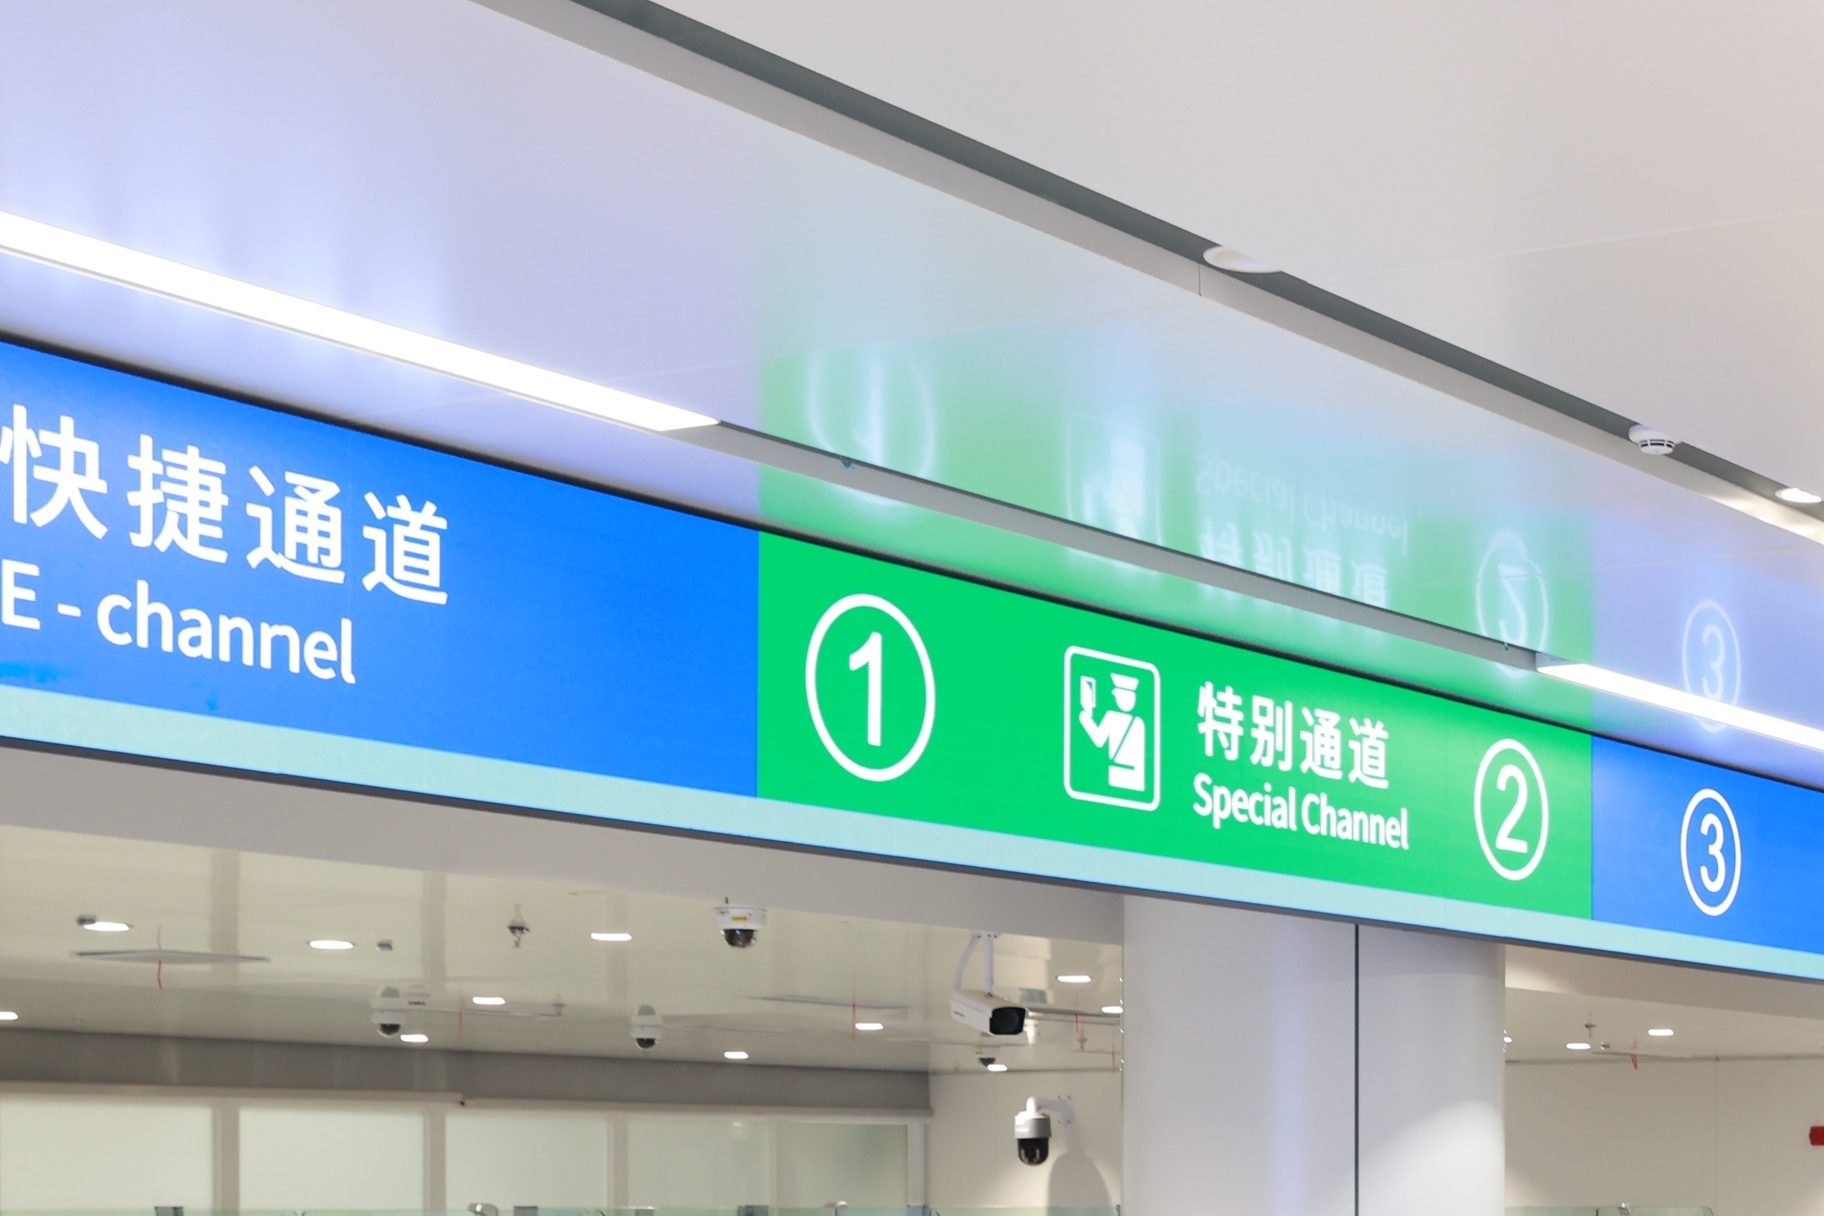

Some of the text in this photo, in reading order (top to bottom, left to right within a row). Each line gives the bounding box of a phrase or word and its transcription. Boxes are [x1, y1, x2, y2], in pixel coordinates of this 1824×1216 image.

[0, 403, 449, 606] 快捷通道
[847, 631, 884, 748] 1
[1194, 681, 1391, 791] 特别通道
[1194, 773, 1410, 851] Special Channel
[1495, 763, 1529, 856] 2
[1699, 812, 1727, 894] 3
